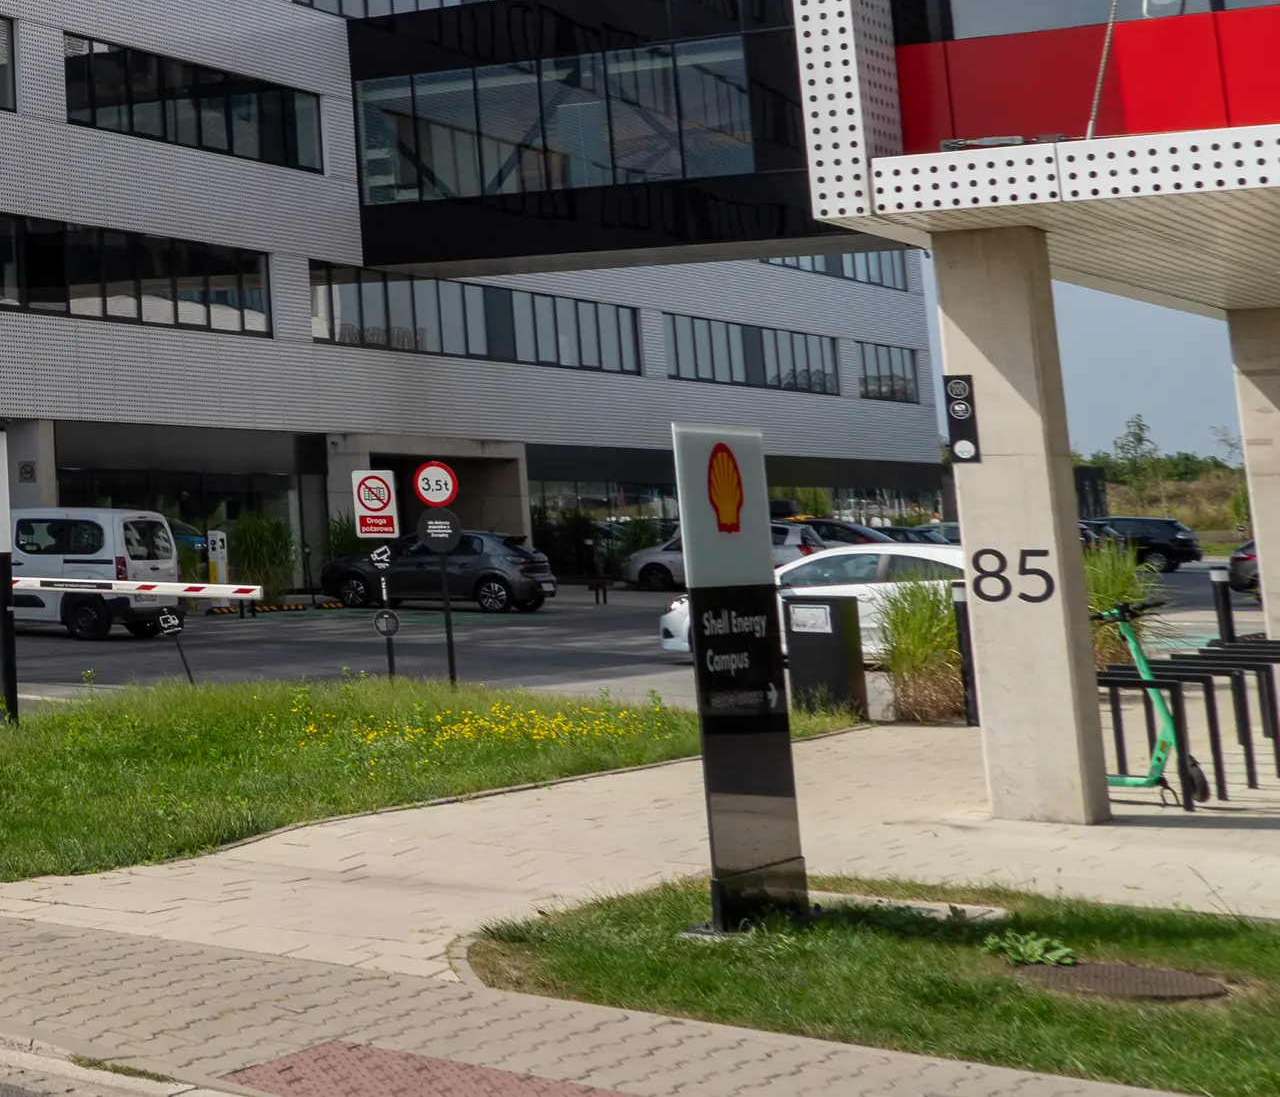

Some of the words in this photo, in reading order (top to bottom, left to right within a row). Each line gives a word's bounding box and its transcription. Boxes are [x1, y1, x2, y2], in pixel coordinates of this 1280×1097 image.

[361, 525, 394, 533] pożarowa
[971, 548, 1055, 603] 85
[703, 609, 730, 636] Shell
[731, 610, 767, 638] Energy
[706, 648, 750, 677] Campus
